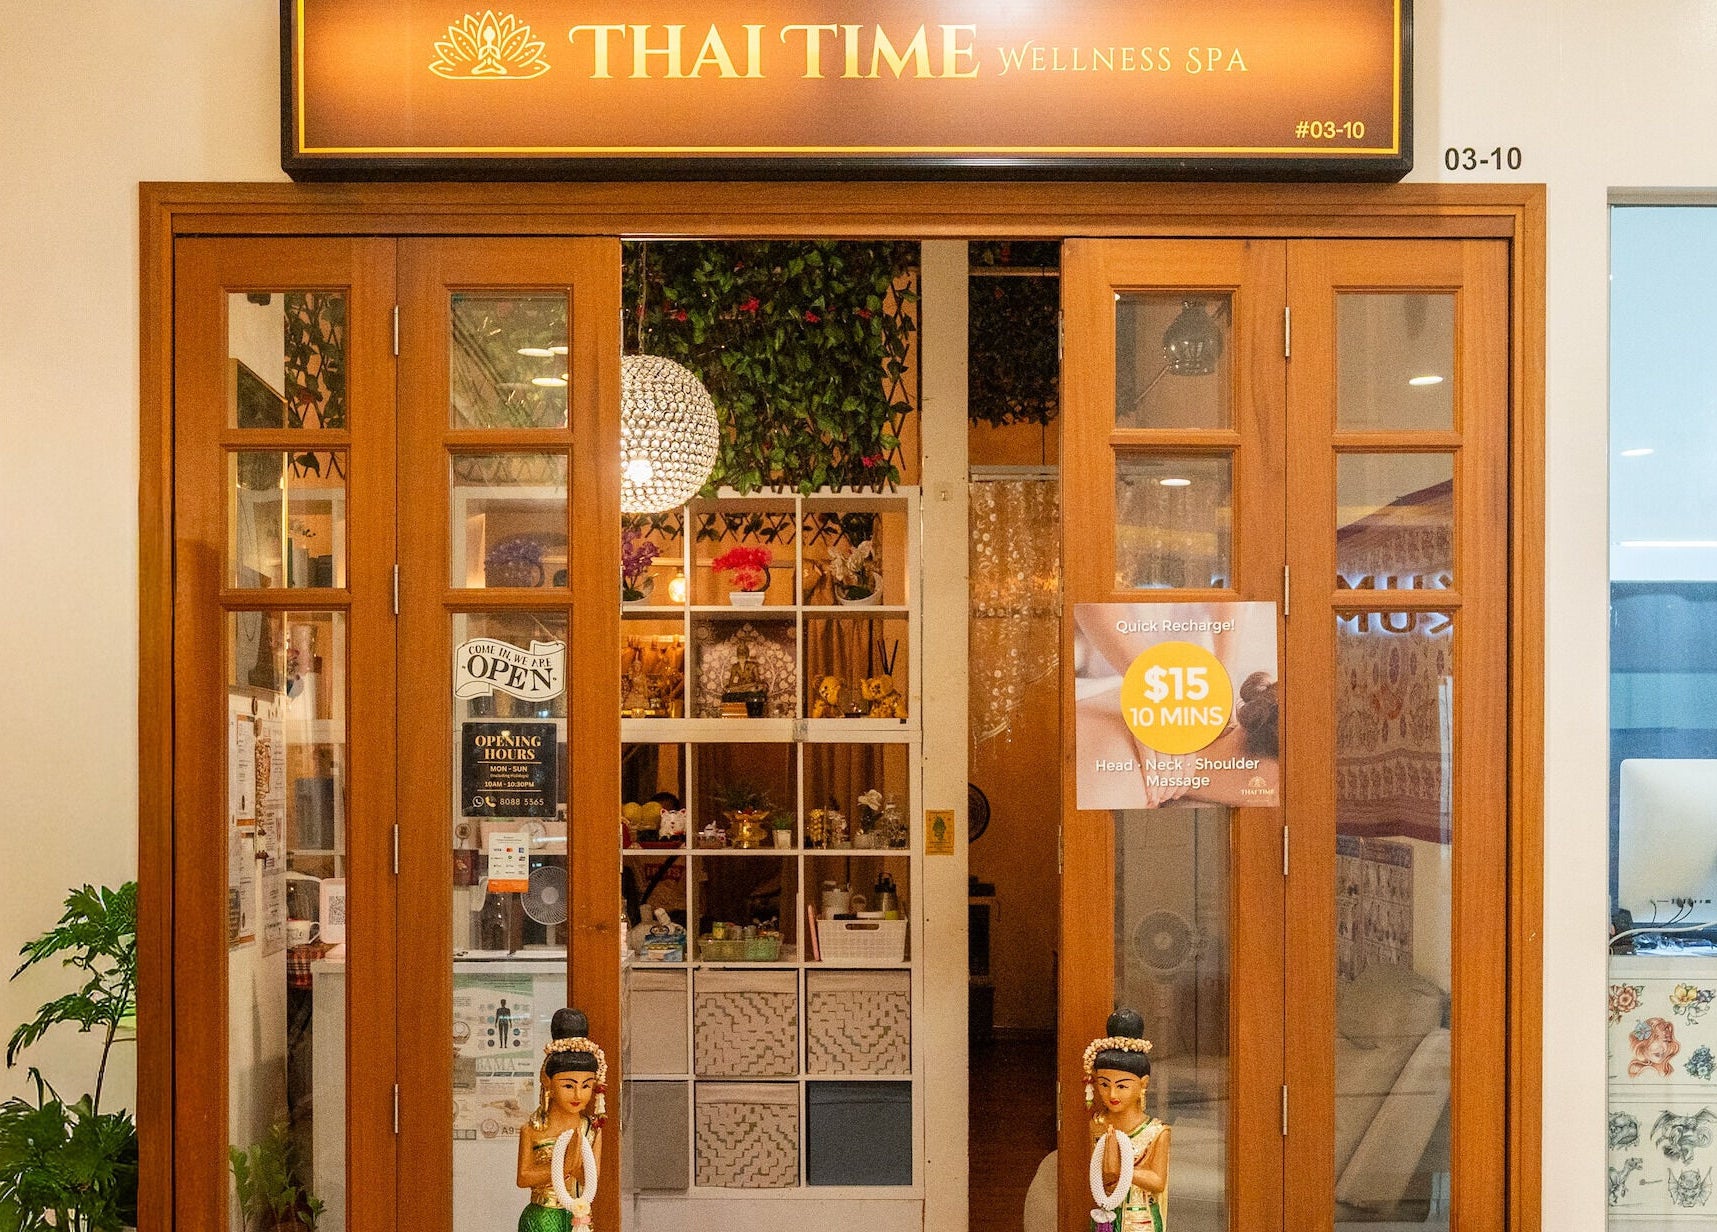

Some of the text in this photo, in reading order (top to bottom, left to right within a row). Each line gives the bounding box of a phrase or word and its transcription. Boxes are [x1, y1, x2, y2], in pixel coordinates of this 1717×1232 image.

[568, 23, 1248, 80] THAI TIME WELLNESS SPA
[1295, 120, 1366, 139] #03-10
[1444, 146, 1523, 171] 03-10
[1116, 619, 1236, 635] Quick Recharge!
[468, 644, 495, 655] COME
[514, 654, 528, 666] WE
[531, 656, 552, 668] ARE
[467, 654, 554, 692] OPEN
[1143, 665, 1210, 704] $15
[1129, 706, 1224, 728] 10 MINS
[475, 735, 542, 747] OPENING
[484, 748, 536, 760] HOURS
[1095, 759, 1134, 772] Head
[1146, 758, 1183, 771] Neck
[1195, 757, 1260, 770] Shoulder
[1146, 775, 1211, 789] Massage
